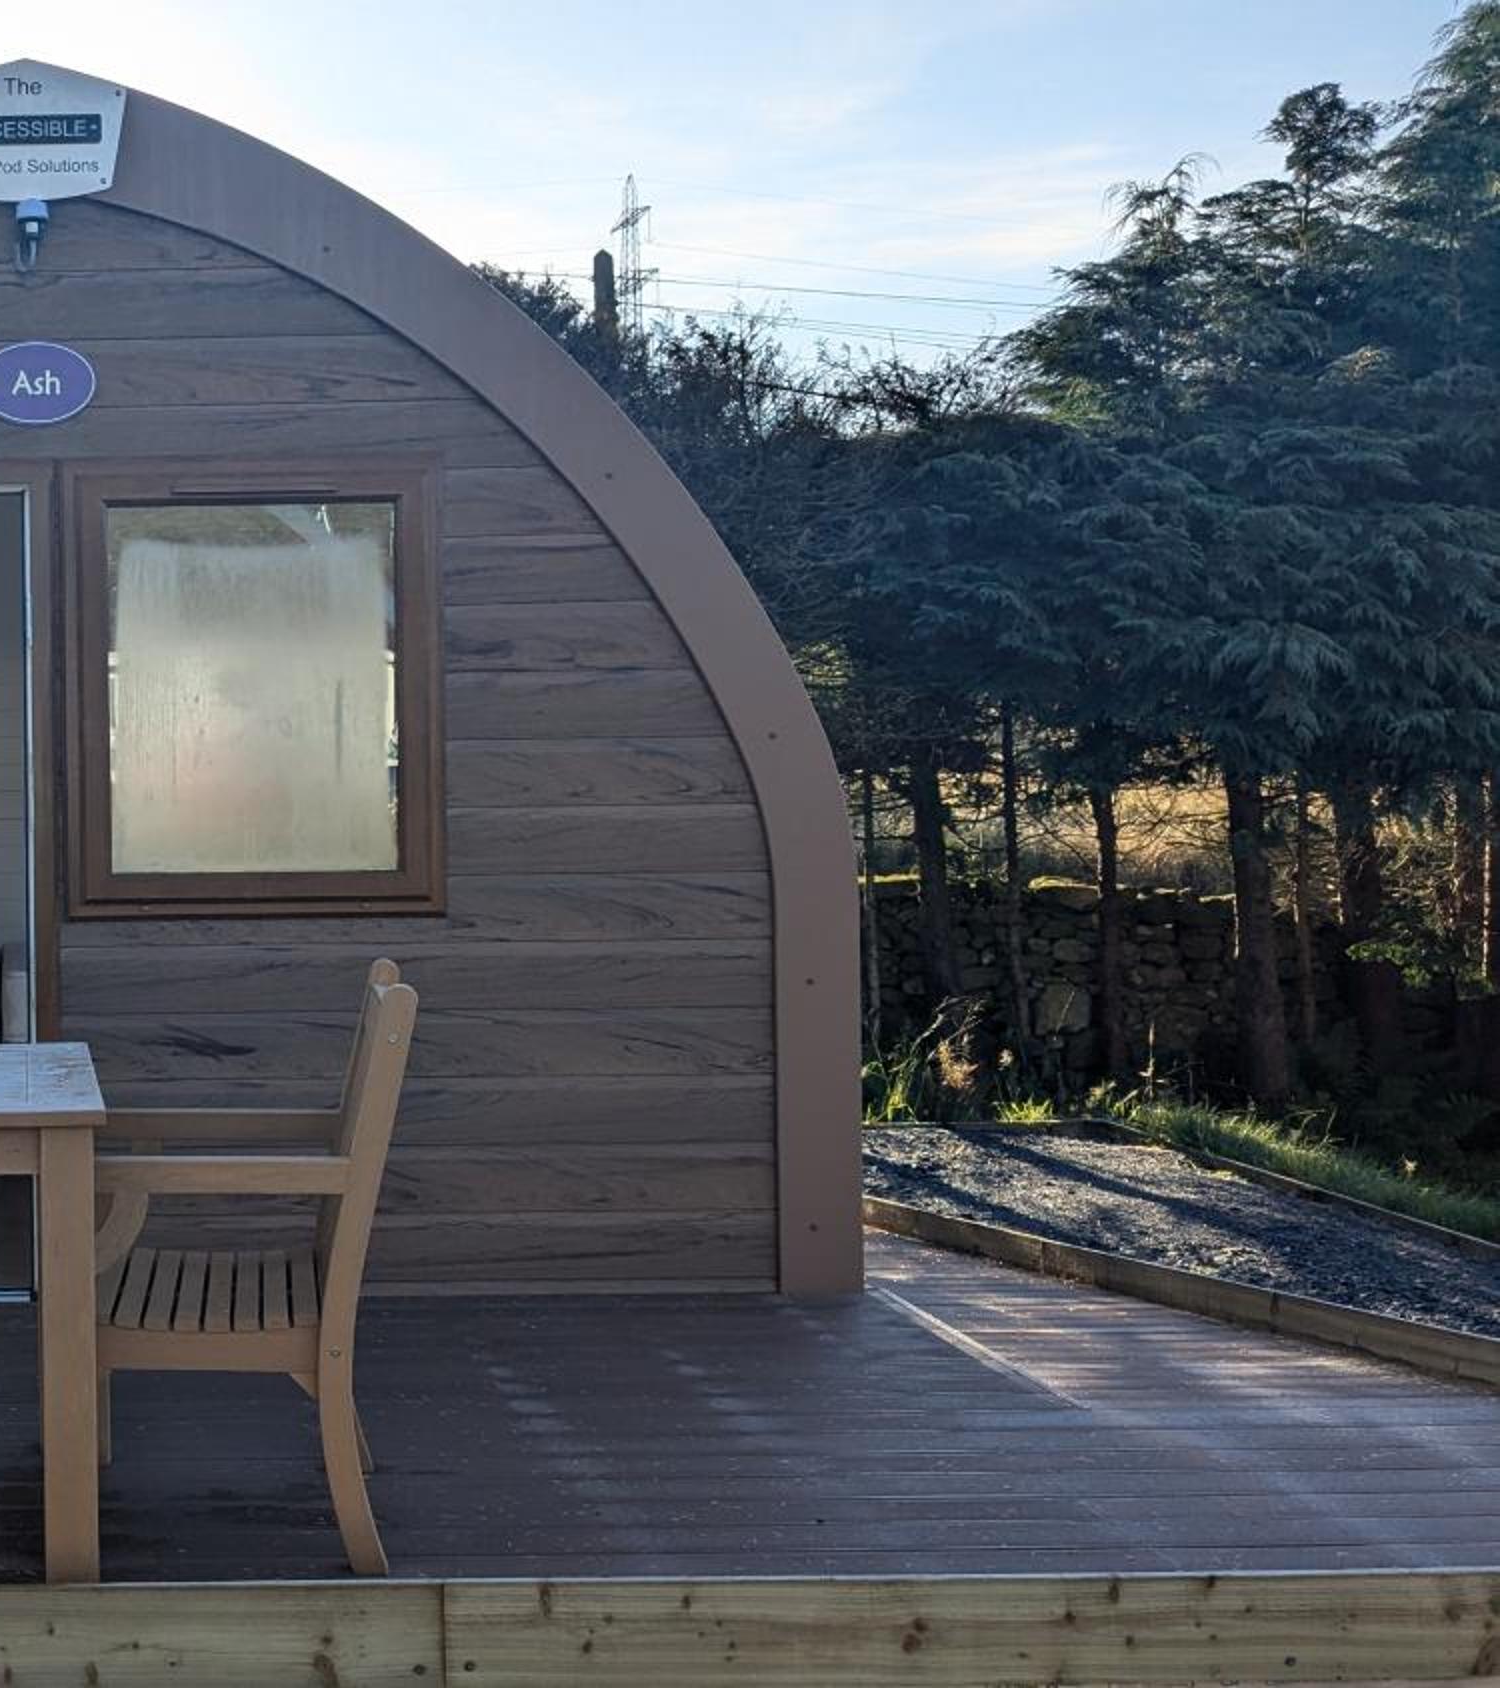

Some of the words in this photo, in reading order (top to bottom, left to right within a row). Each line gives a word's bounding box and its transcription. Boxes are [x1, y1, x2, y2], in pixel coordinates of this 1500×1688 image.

[4, 77, 42, 95] The
[27, 158, 100, 173] Solutions
[11, 370, 61, 395] Ash
